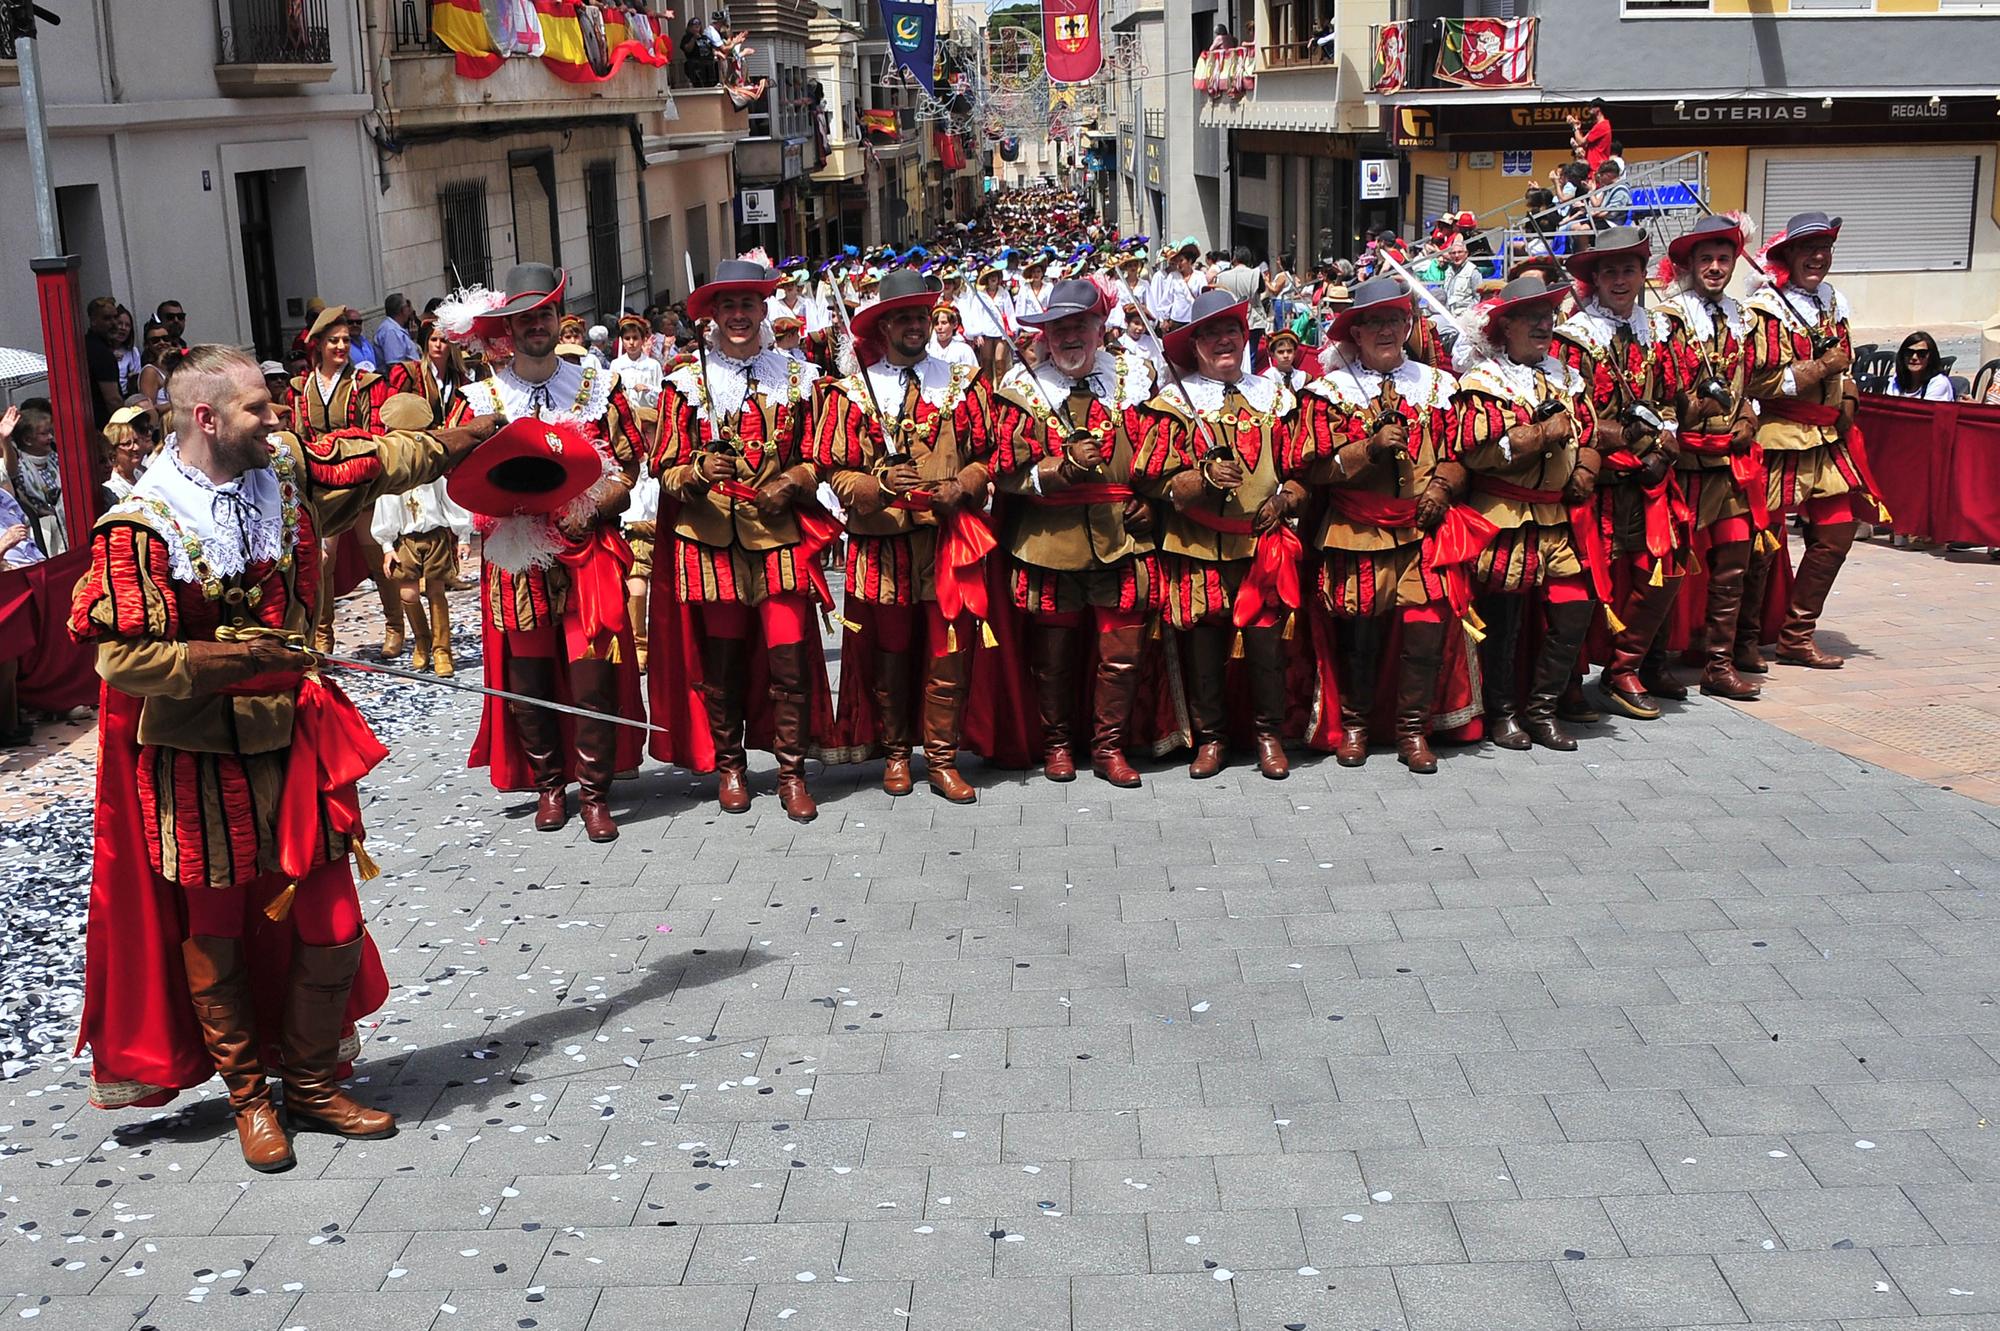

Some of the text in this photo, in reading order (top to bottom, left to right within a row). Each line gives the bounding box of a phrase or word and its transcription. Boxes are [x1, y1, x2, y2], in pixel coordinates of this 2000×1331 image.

[1534, 106, 1591, 120] ESTANC
[1679, 106, 1807, 120] LOTERIAS
[1891, 104, 1947, 117] REGALOS
[1399, 138, 1434, 146] ESTANCO
